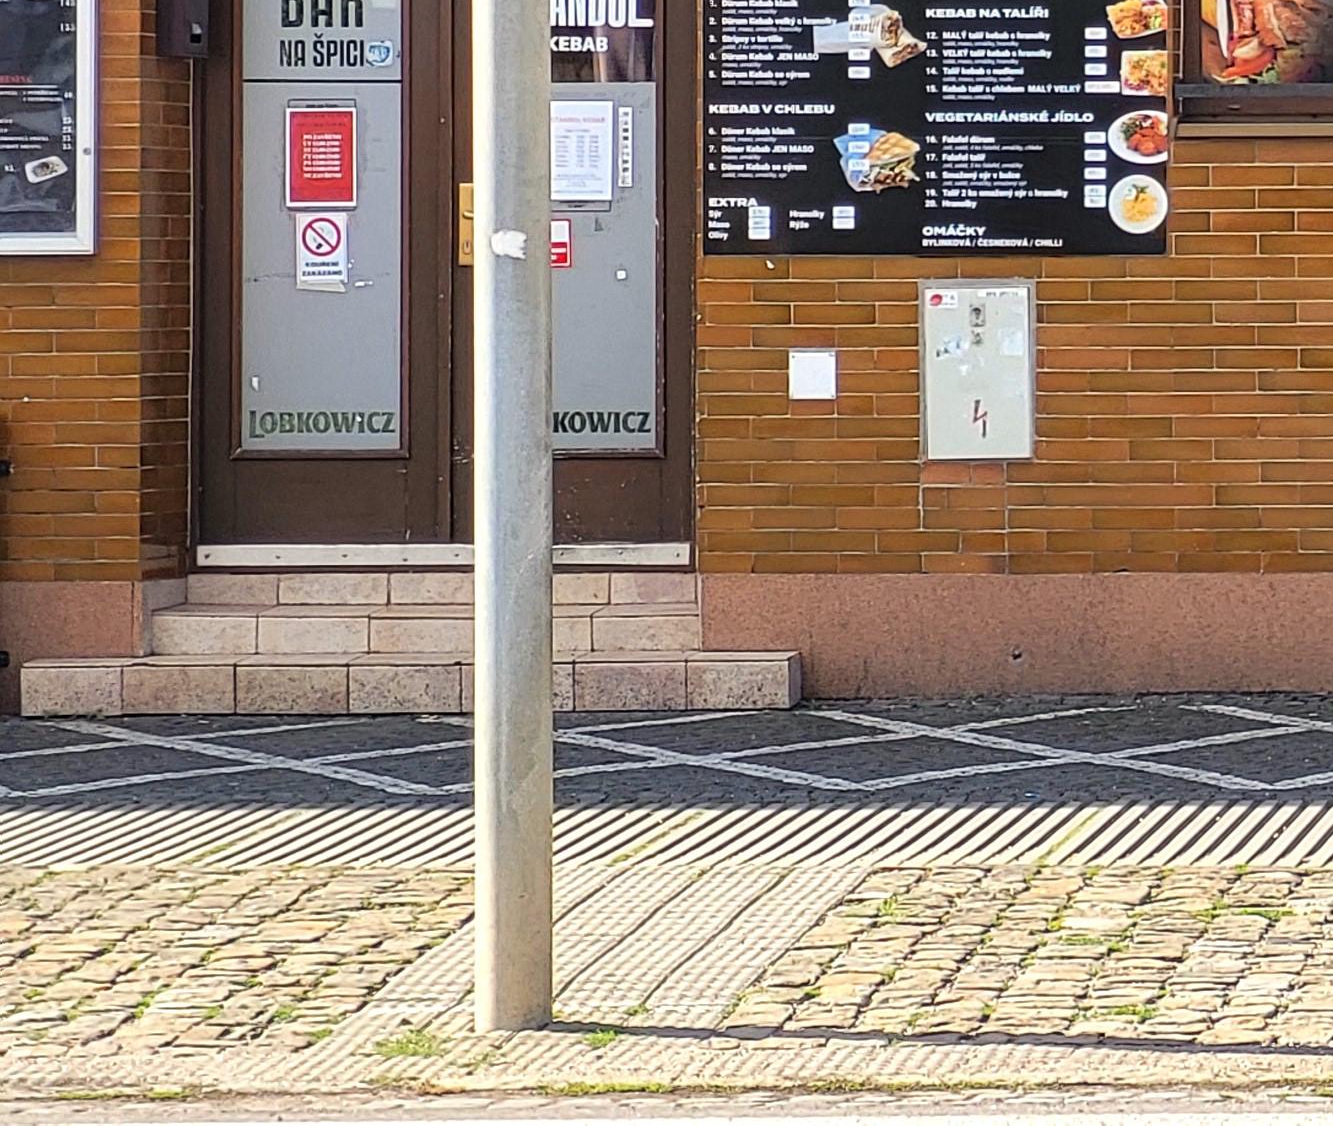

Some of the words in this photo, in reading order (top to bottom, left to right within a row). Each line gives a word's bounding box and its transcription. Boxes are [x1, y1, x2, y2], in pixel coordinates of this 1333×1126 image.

[925, 8, 976, 18] KEBAB
[979, 8, 1001, 18] NA
[1002, 6, 1049, 18] TALÍŘI
[280, 40, 305, 67] NA
[313, 33, 364, 67] ŠPICI
[550, 36, 609, 52] KEBAB
[708, 104, 760, 114] KEBAB
[762, 104, 772, 114] V
[774, 104, 835, 114] CHLEBU
[925, 110, 1049, 123] VEGETARIÁNSKÉ
[1051, 110, 1095, 123] JÍDLO
[708, 197, 758, 207] EXTRA
[922, 224, 986, 236] OMÁČKY
[249, 410, 395, 438] LOBKOWICZ
[553, 411, 651, 433] KOWICZ
